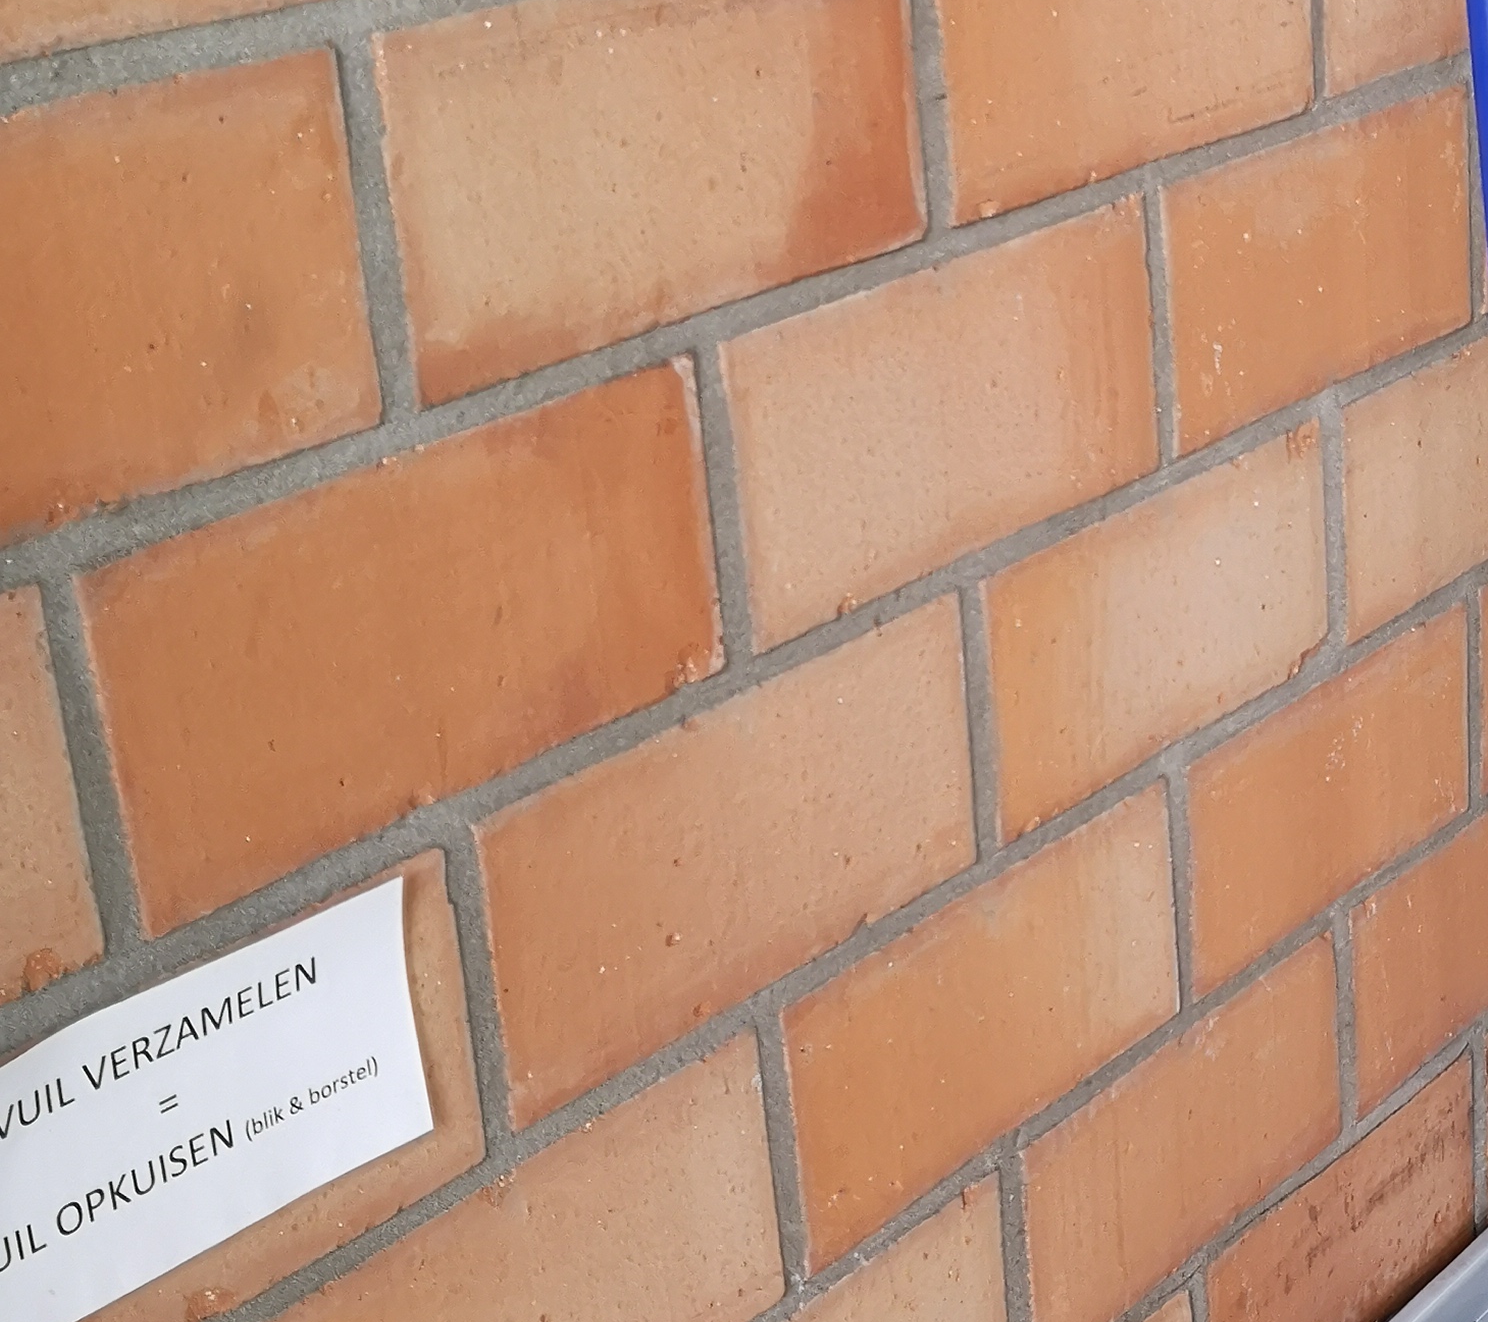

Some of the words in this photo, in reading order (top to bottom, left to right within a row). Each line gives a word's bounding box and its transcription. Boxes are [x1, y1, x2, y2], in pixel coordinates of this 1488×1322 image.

[82, 957, 317, 1090] VERZAMELEN
[56, 1120, 234, 1236] OPKUISEN
[245, 1108, 285, 1142] (blik
[289, 1096, 304, 1115] &
[308, 1056, 379, 1106] borstel)
